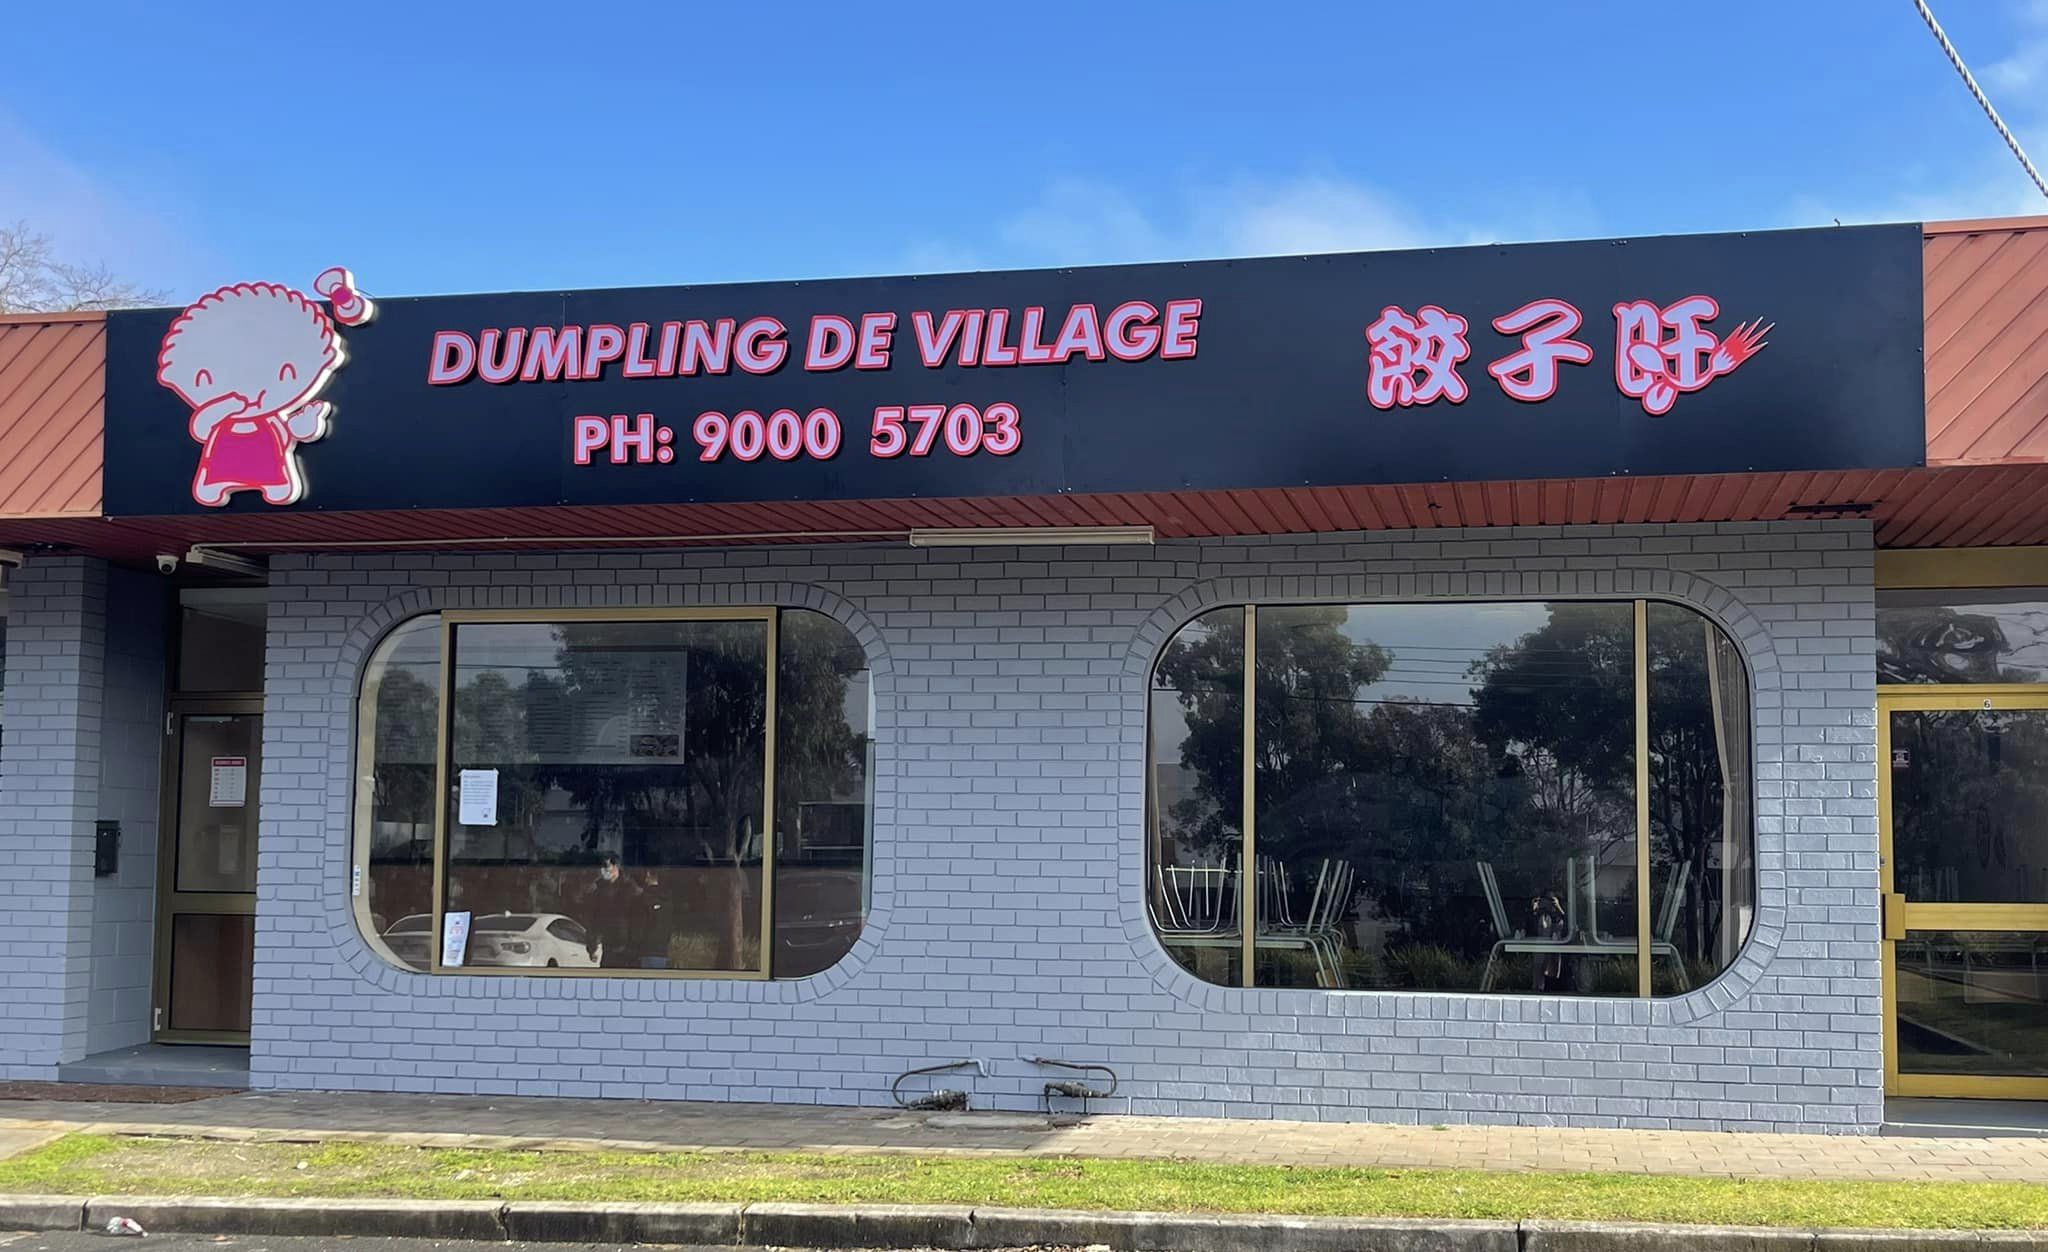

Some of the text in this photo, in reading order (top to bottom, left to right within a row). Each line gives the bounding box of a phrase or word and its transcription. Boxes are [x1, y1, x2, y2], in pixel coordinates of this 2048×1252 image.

[428, 300, 1202, 385] DUMPLING DE VILLAGE
[573, 402, 1022, 464] PH: 9000 5703
